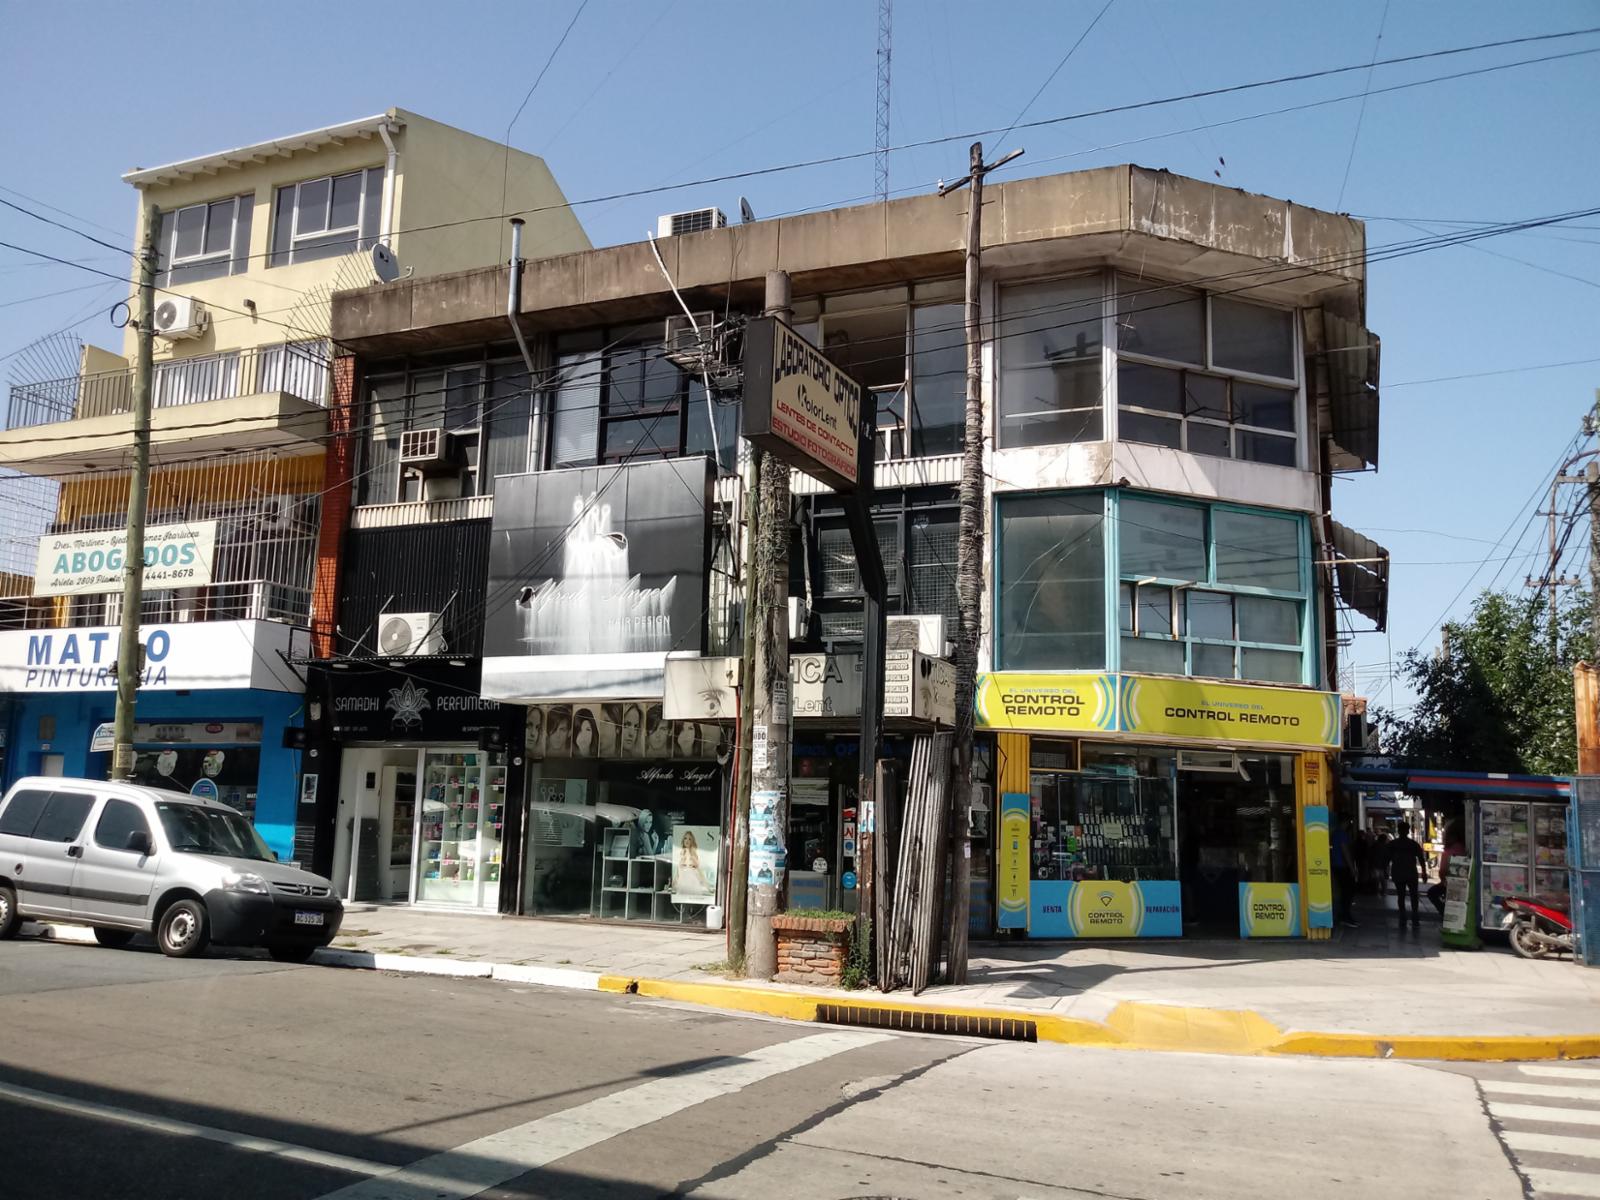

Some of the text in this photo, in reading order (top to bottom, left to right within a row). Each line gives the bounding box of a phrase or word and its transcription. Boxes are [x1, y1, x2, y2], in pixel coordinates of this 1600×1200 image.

[775, 323, 830, 392] LABORATORIO
[777, 400, 854, 457] LENTES DE CONTACTO
[772, 418, 856, 477] ESTUDIO FOTOGRAFICO
[53, 542, 196, 574] ABOGDOS
[634, 616, 670, 625] DESIGN
[27, 629, 171, 666] MATO
[25, 666, 168, 688] PINTURIA
[335, 697, 379, 711] SAMADHI
[1001, 694, 1085, 705] CONTROL
[1211, 701, 1249, 710] UNIVERSO
[1005, 705, 1080, 717] REMOTO
[1165, 707, 1300, 727] CONTROL REMOTO
[680, 766, 717, 786] Angel
[1042, 905, 1062, 914] VENTA
[1253, 904, 1286, 912] CONTROL
[1255, 912, 1285, 920] REMOTO
